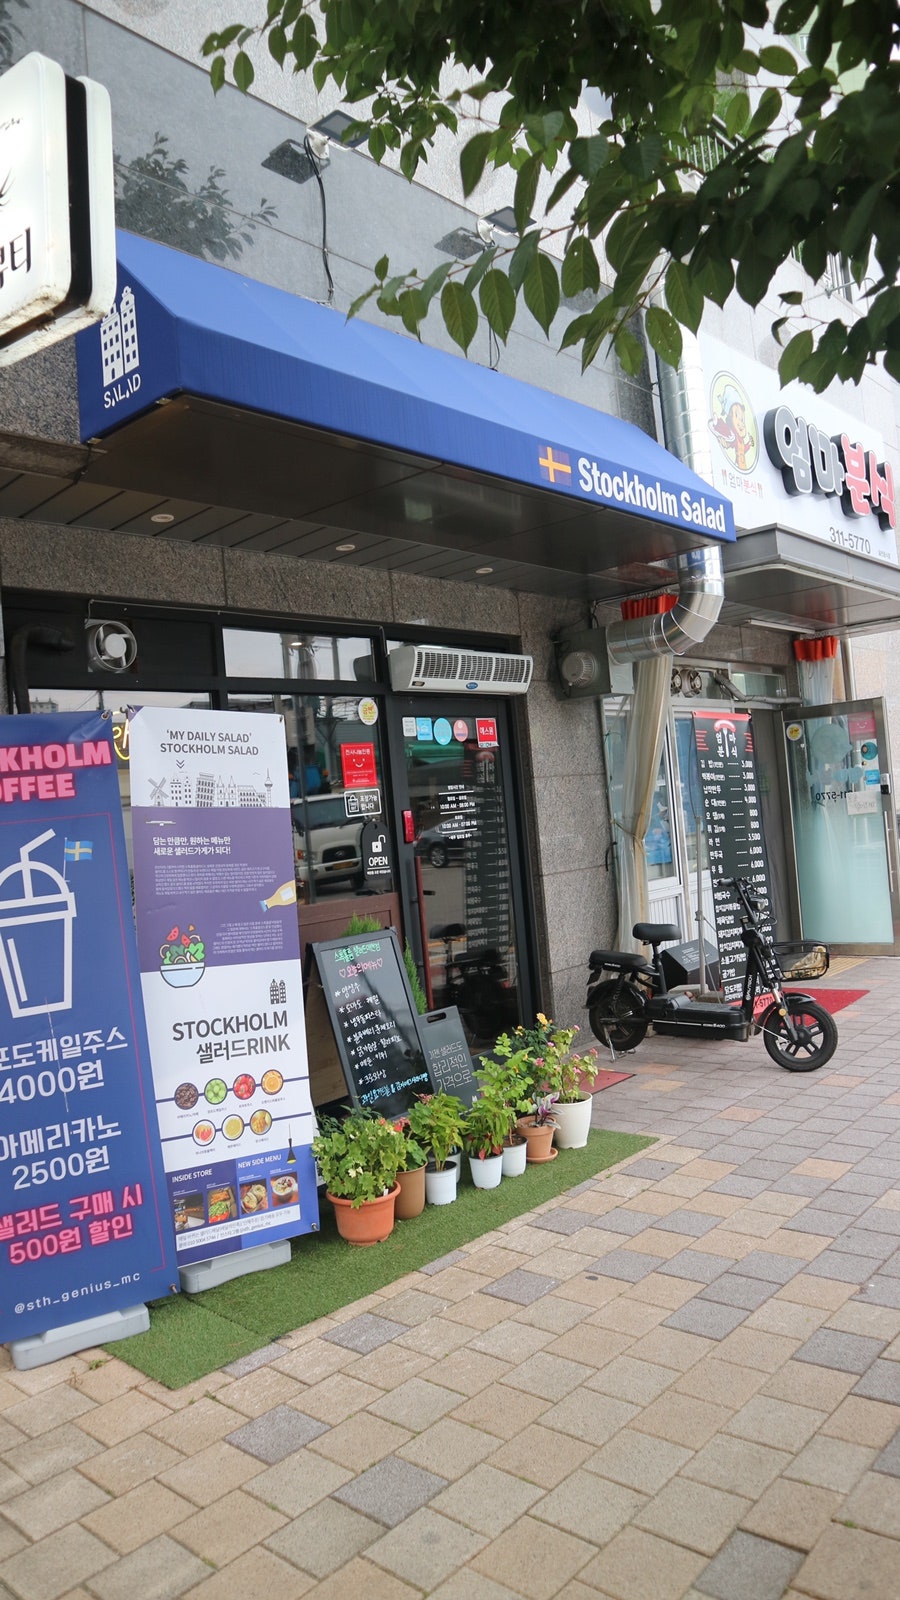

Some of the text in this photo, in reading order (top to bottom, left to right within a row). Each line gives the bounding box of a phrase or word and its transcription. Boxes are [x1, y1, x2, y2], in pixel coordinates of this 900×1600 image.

[765, 404, 896, 531] 엄마분식
[577, 456, 727, 533] Stockholm Salad
[829, 526, 871, 555] 311-5770
[160, 742, 259, 756] STOCKHOLM SALAD
[187, 731, 216, 742] DAILY
[0, 773, 76, 803] FFEE
[368, 856, 389, 867] OPEN
[172, 1010, 288, 1041] STOCKHOLM
[196, 1033, 291, 1064] 샐러드RINK
[432, 1053, 468, 1077] 합리적인
[436, 1068, 473, 1092] 가격으로
[0, 1059, 105, 1105] 4000원
[0, 1114, 122, 1161] 아메리카노
[12, 1145, 111, 1191] 2500원
[171, 1168, 213, 1183] INSIDE STORE
[237, 1154, 282, 1169] NEW SIDE MENU
[68, 1189, 114, 1222] 구매
[121, 1182, 144, 1210] 시
[8, 1224, 82, 1266] 500원
[88, 1213, 134, 1246] 할인
[14, 1271, 142, 1315] @sth_genius_mc
